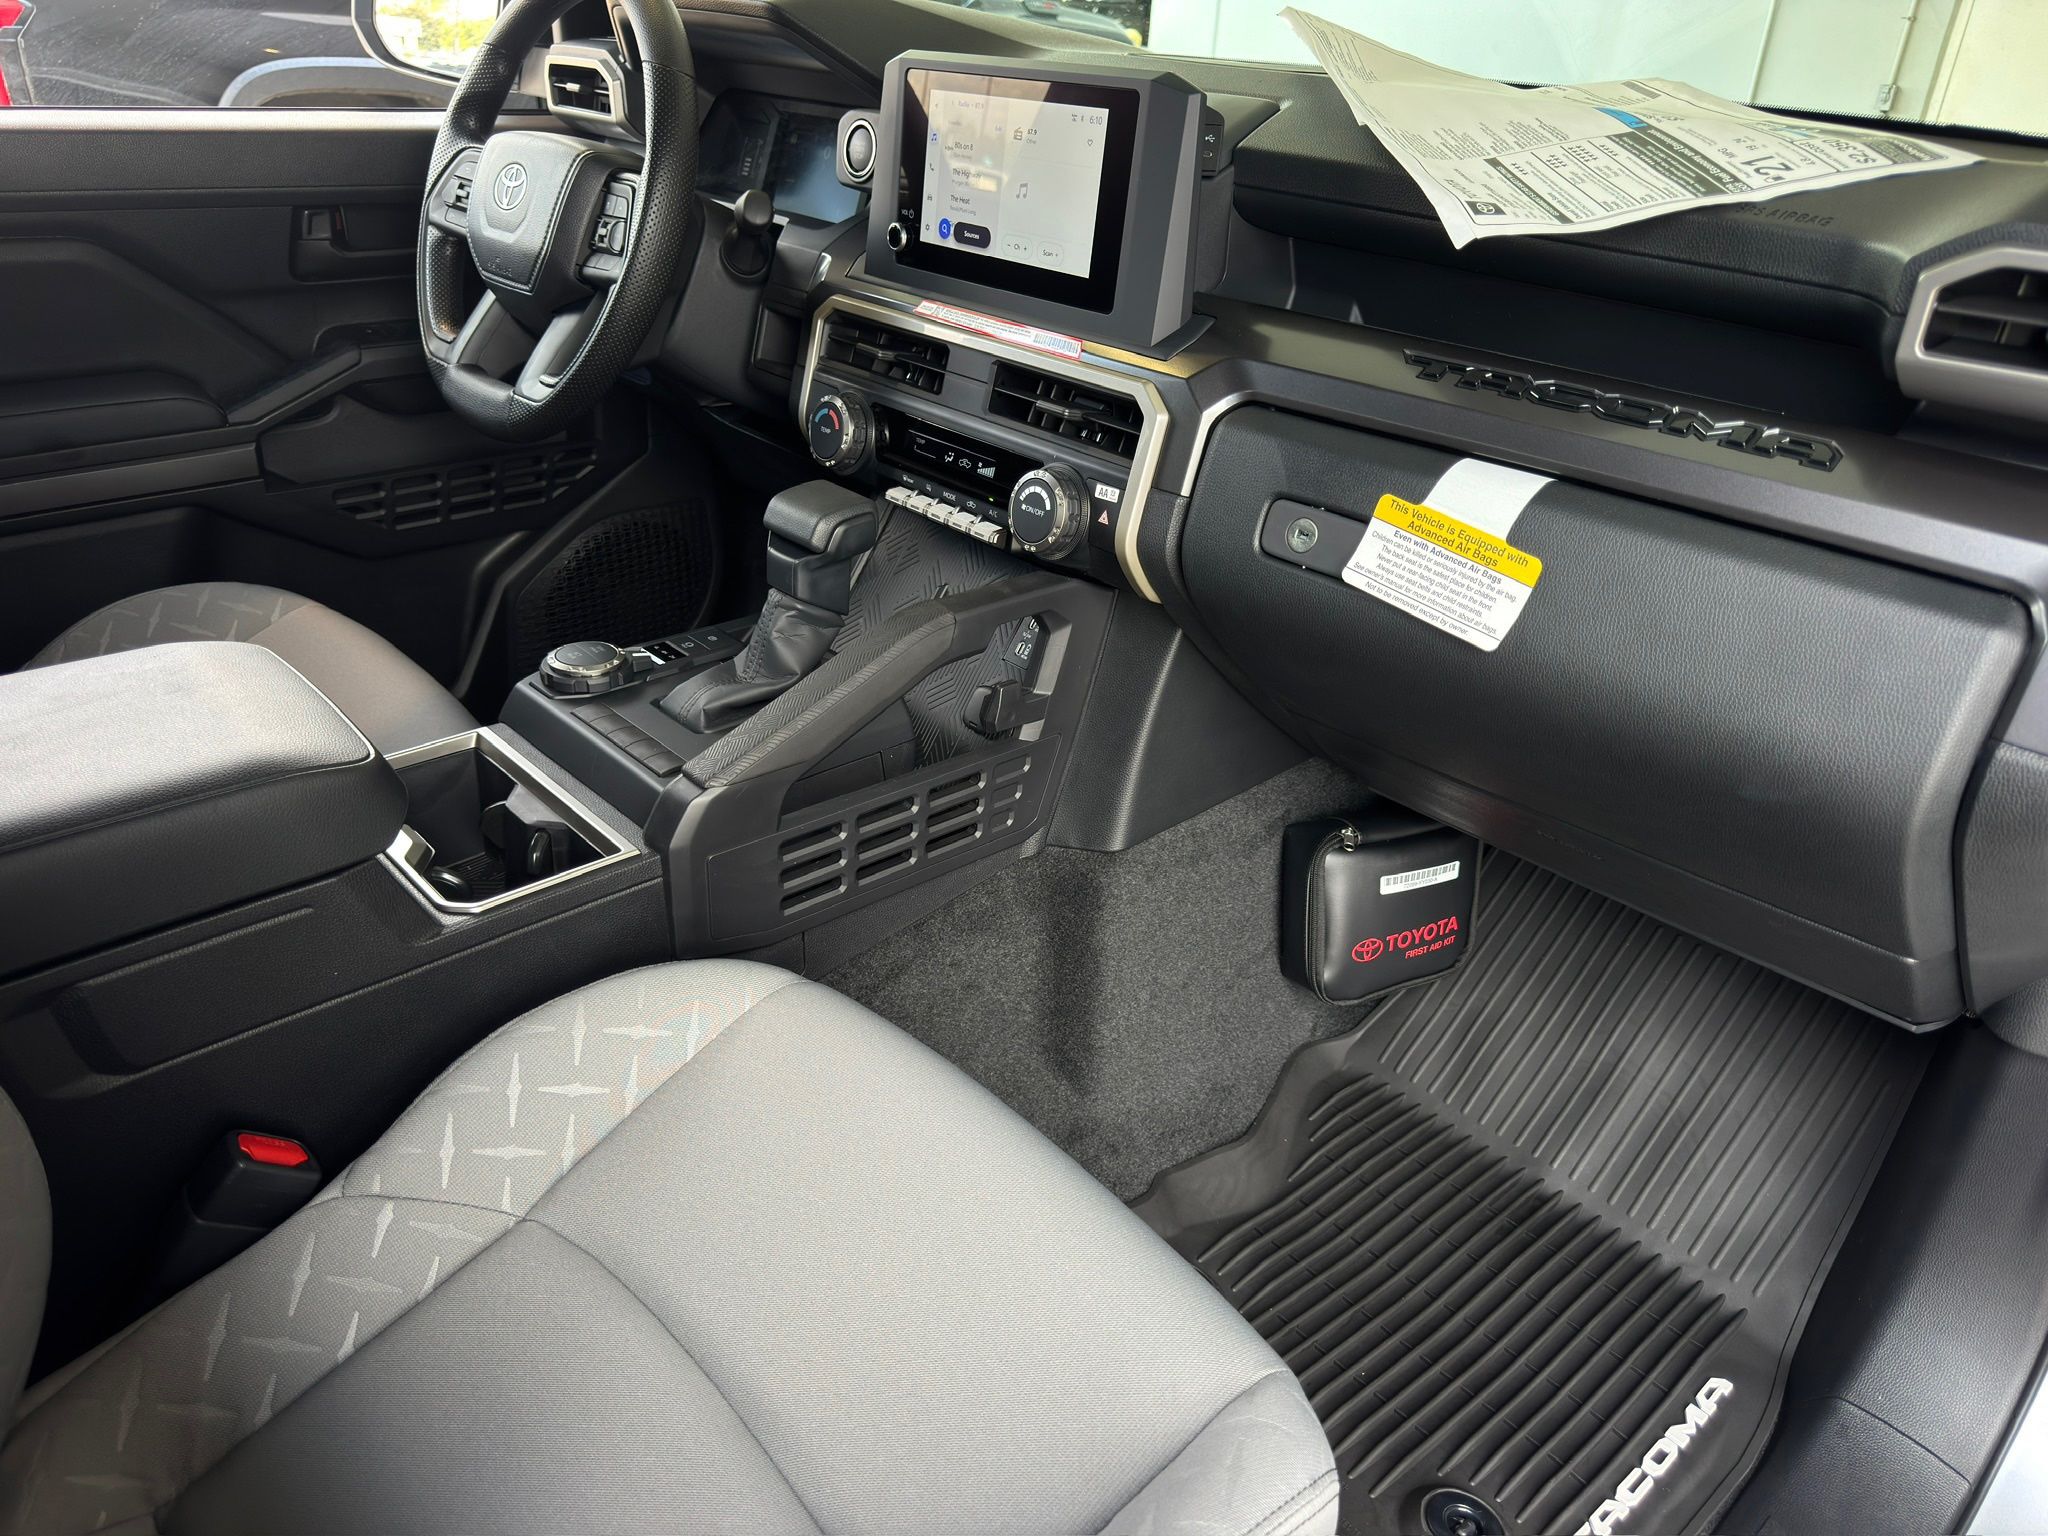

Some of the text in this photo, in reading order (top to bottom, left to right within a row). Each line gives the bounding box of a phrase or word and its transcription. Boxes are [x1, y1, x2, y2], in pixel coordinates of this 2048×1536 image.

[1089, 115, 1103, 126] 6:10
[1647, 129, 1684, 152] Environment
[1683, 148, 1696, 157] and
[1695, 154, 1722, 177] Economy
[1740, 155, 1794, 176] 21
[1720, 172, 1734, 183] Fuel
[1767, 208, 1834, 227] AIRBAG
[963, 230, 980, 240] Sources
[1402, 349, 1845, 472] TACOMA
[1099, 488, 1108, 498] AA
[1026, 505, 1044, 518] ON/OFF
[1388, 499, 1529, 567] This Vehicle is Equipped with
[1406, 520, 1499, 568] Advanced Air Bags
[1393, 530, 1503, 585] Even with Advanced Air Bags
[1364, 580, 1468, 635] Not to be removed except by owner.
[1387, 916, 1458, 951] TOYOTA
[1405, 935, 1456, 959] FIRST AID KIT
[1573, 1377, 1734, 1536] ACOMA
